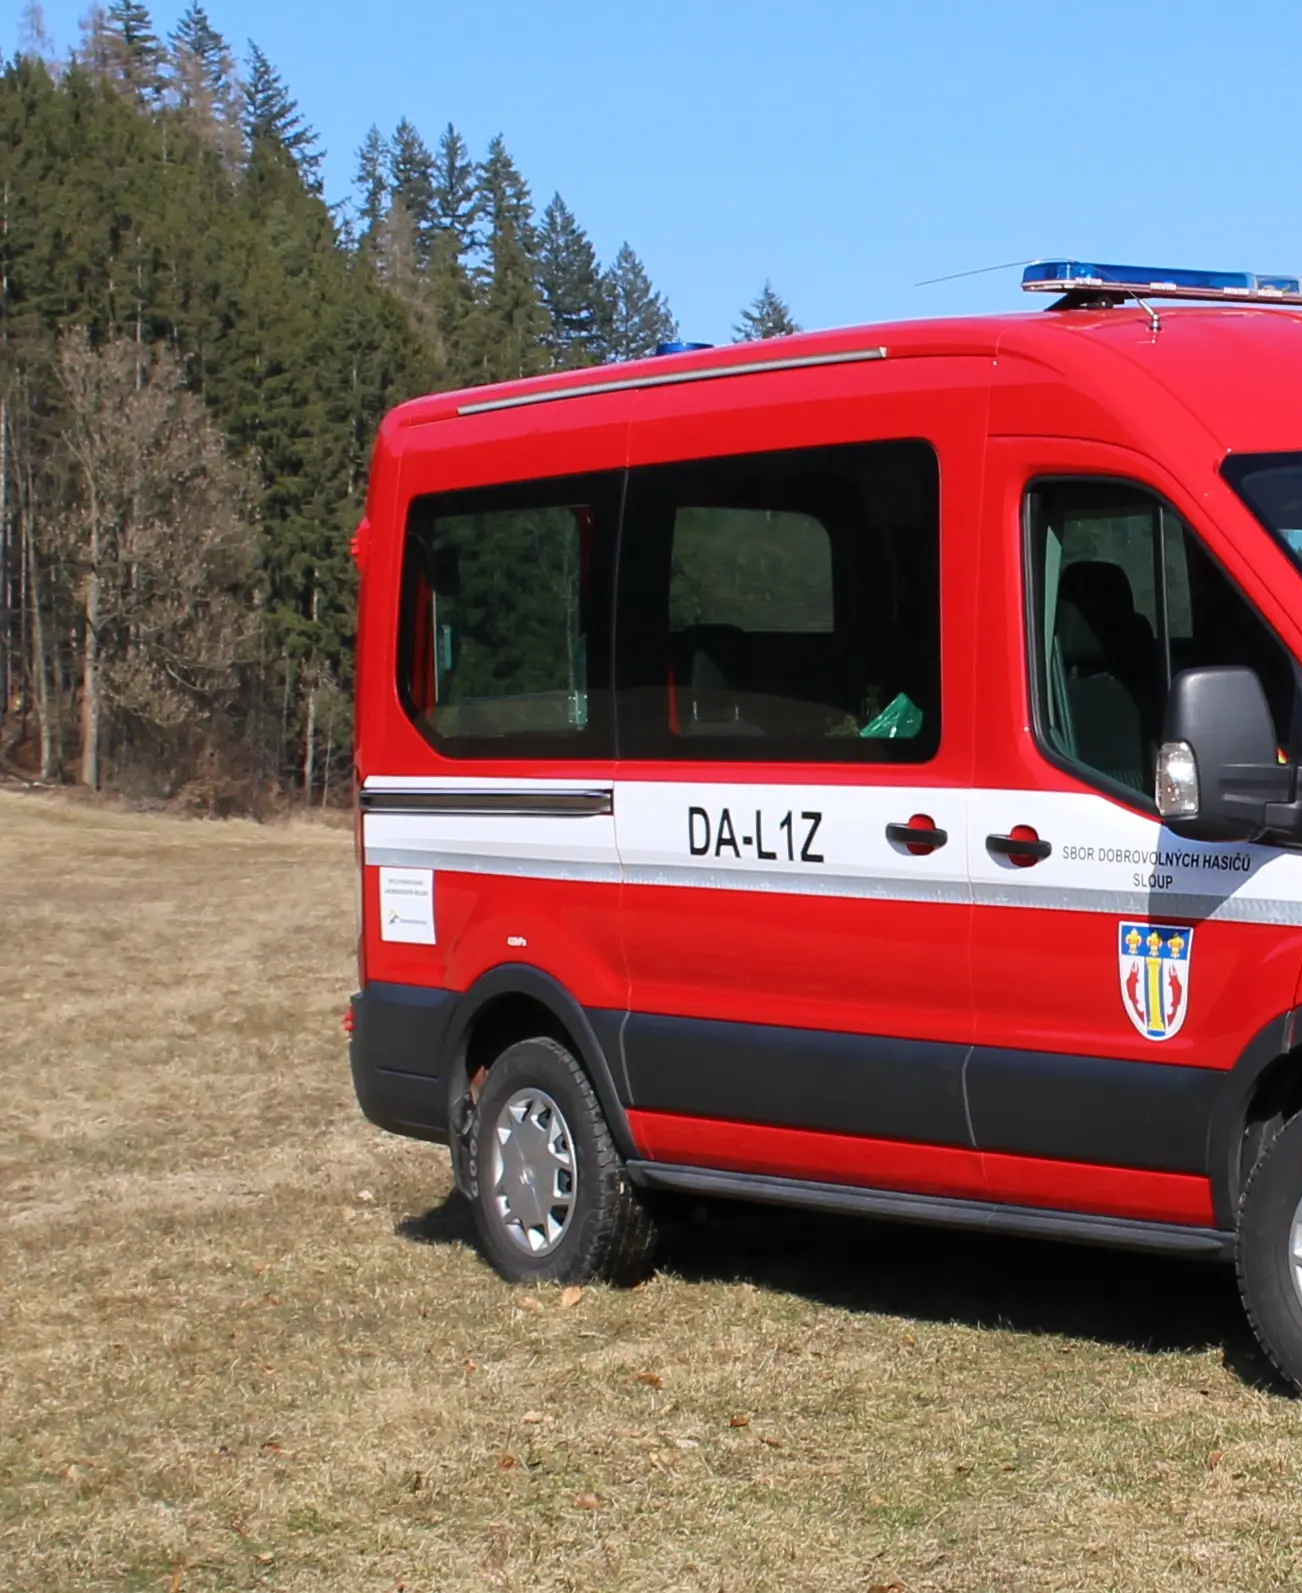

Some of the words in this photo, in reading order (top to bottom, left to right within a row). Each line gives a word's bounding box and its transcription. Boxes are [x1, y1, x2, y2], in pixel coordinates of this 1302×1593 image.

[688, 806, 824, 863] DA-L1Z
[1062, 846, 1094, 861] SBOR
[1099, 848, 1199, 868] DOBROVOLNÝCH
[1203, 852, 1250, 872] HASIČŮ
[1133, 873, 1173, 889] SLOUP
